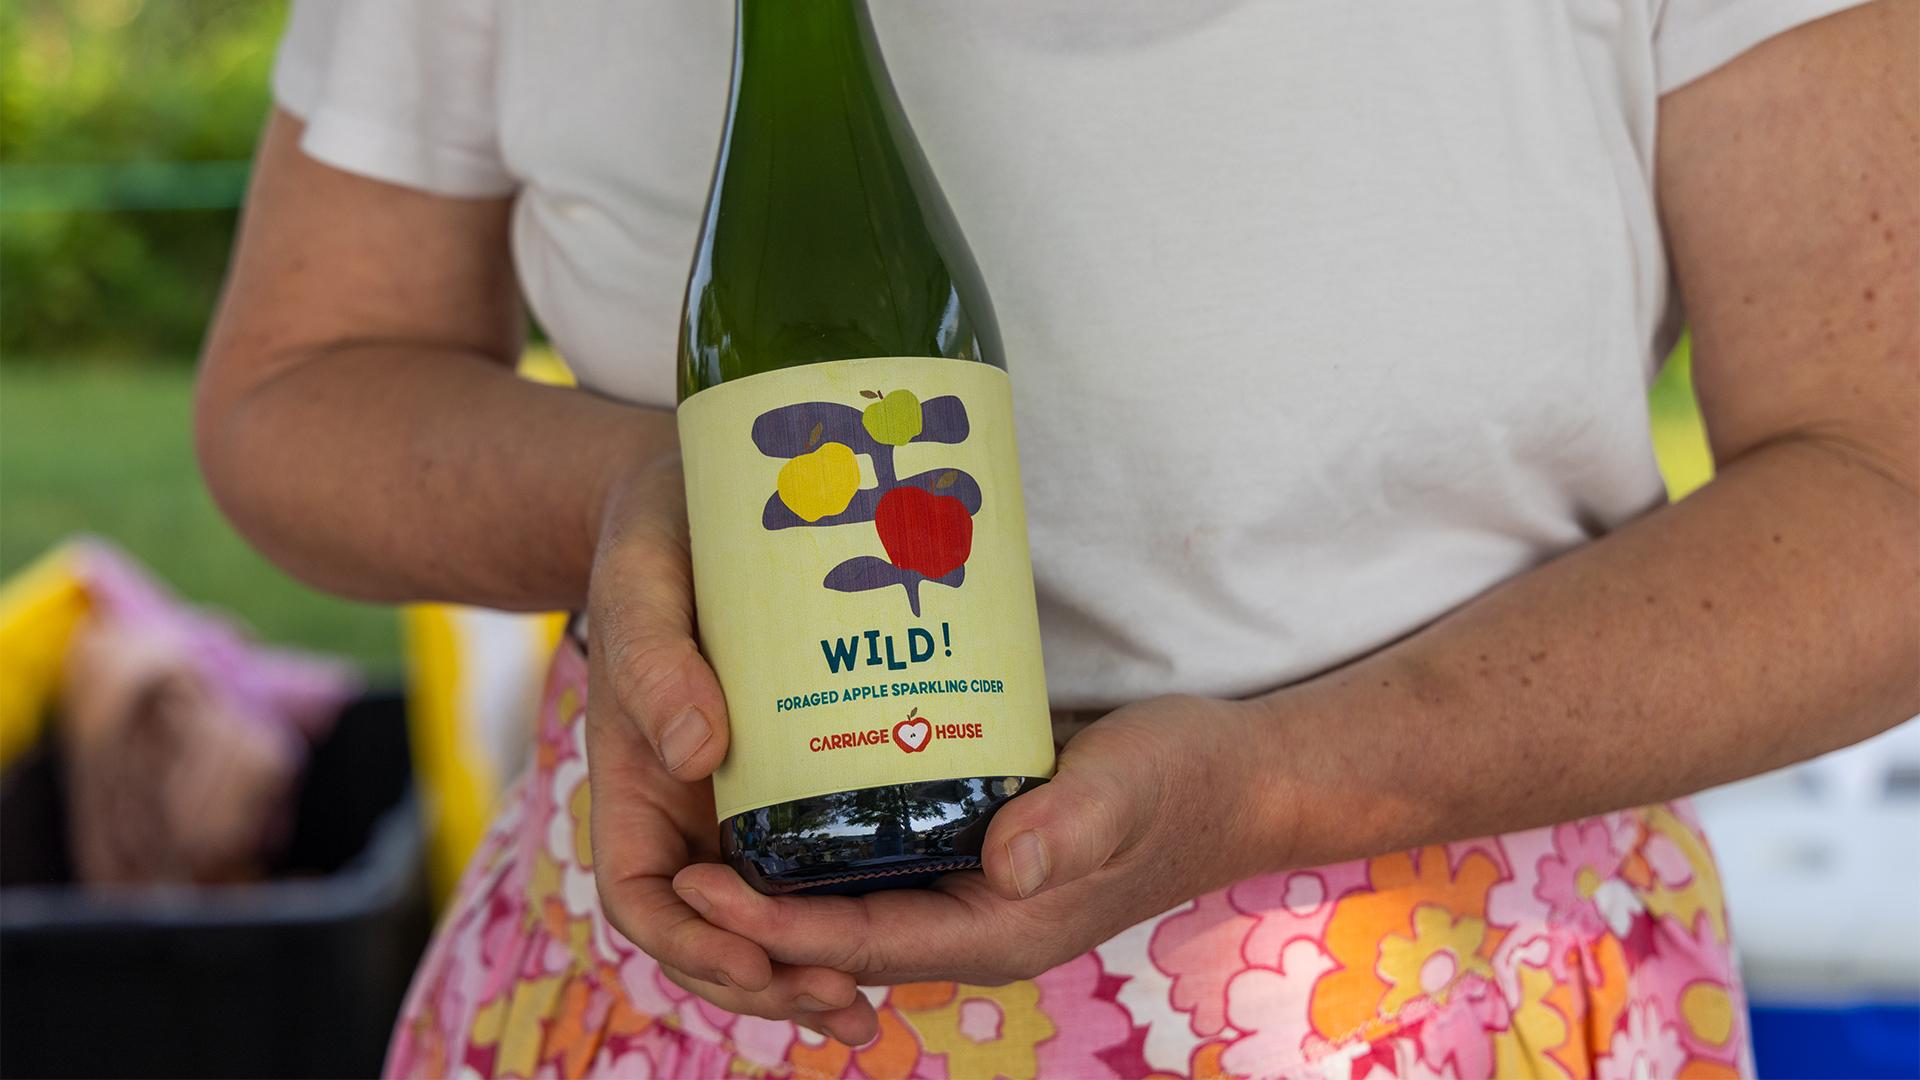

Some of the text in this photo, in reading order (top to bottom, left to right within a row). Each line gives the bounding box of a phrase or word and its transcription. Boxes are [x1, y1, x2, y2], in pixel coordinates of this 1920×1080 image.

[820, 622, 952, 673] WILD!
[777, 679, 1004, 712] FORAGED APPLE SPARKLING CIDER
[809, 723, 983, 752] CARRIAGE HOUSE
